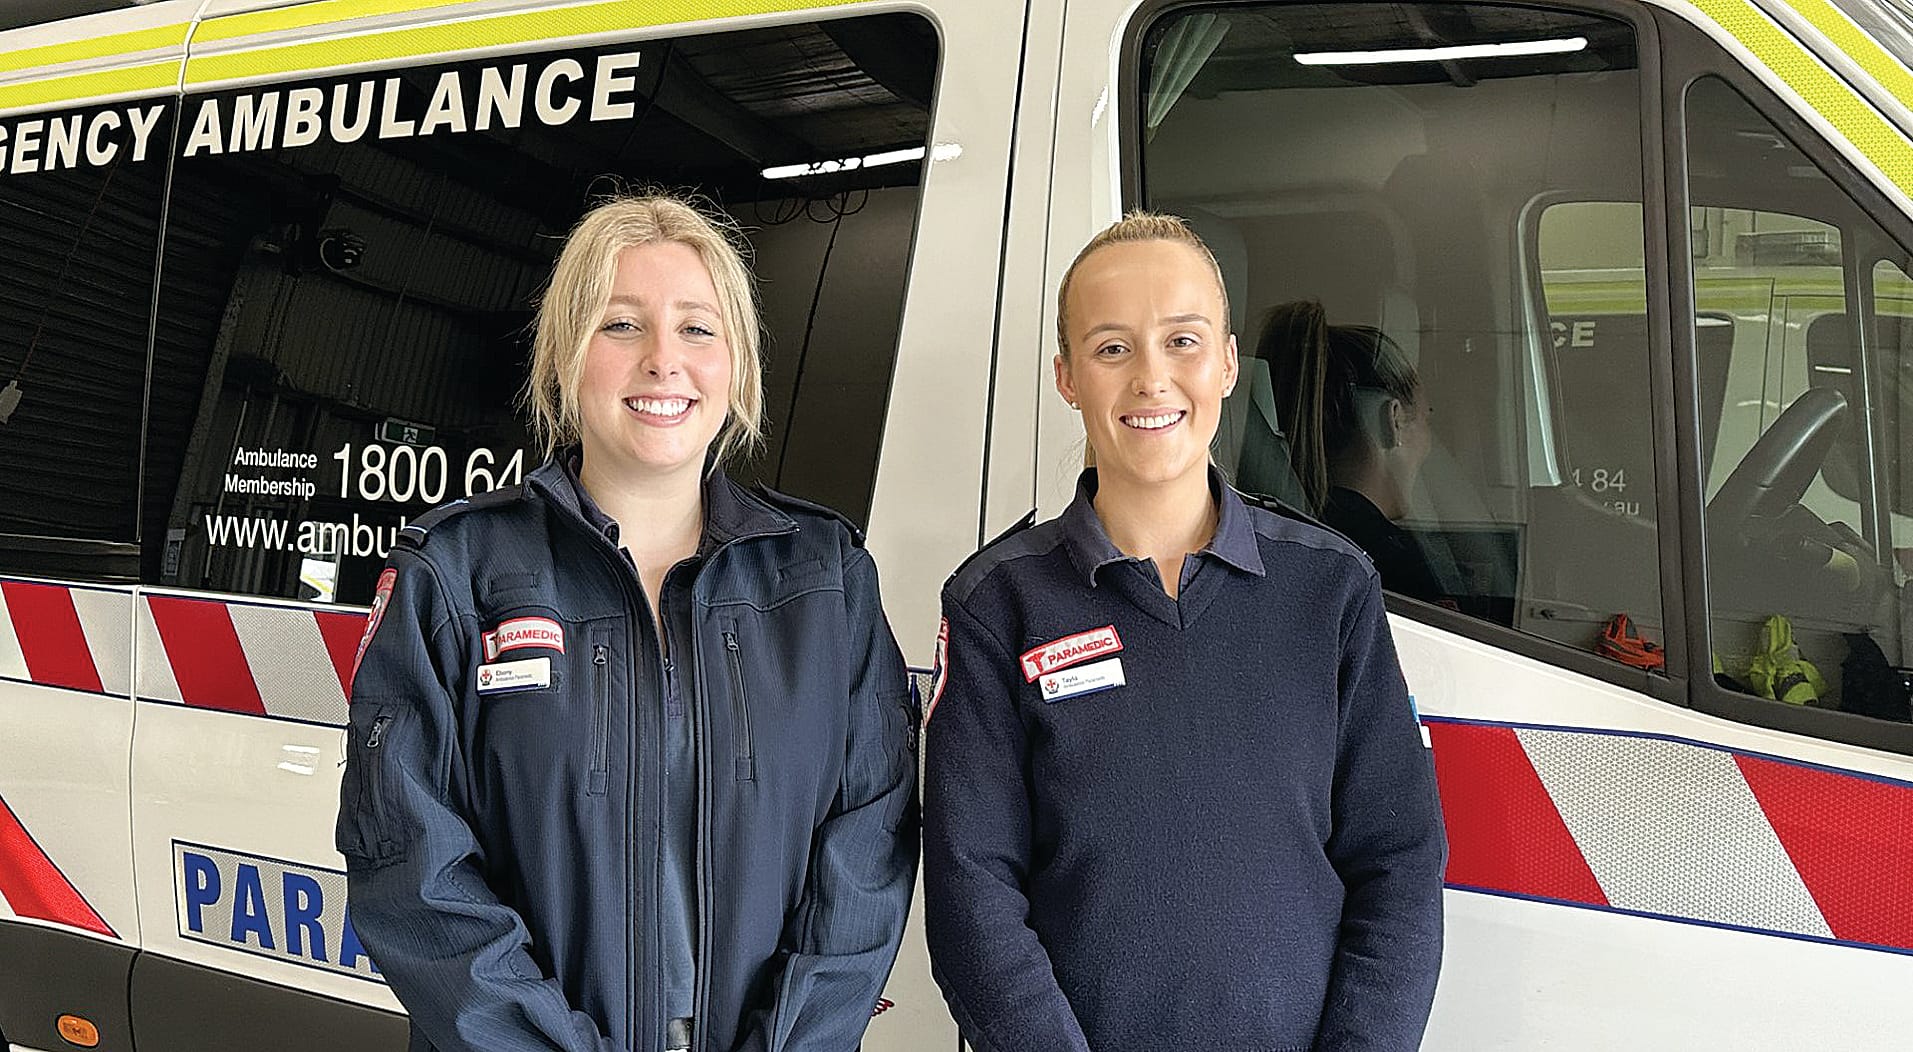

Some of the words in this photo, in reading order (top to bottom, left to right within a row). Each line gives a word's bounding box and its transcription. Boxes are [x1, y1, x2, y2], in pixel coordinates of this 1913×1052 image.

[0, 105, 165, 175] ENCY
[184, 52, 641, 157] AMBULANCE
[234, 447, 318, 469] Ambulance
[333, 443, 448, 503] 1800
[1591, 468, 1627, 492] 84
[224, 474, 316, 501] Membership
[1047, 637, 1113, 665] PARAMEDIC
